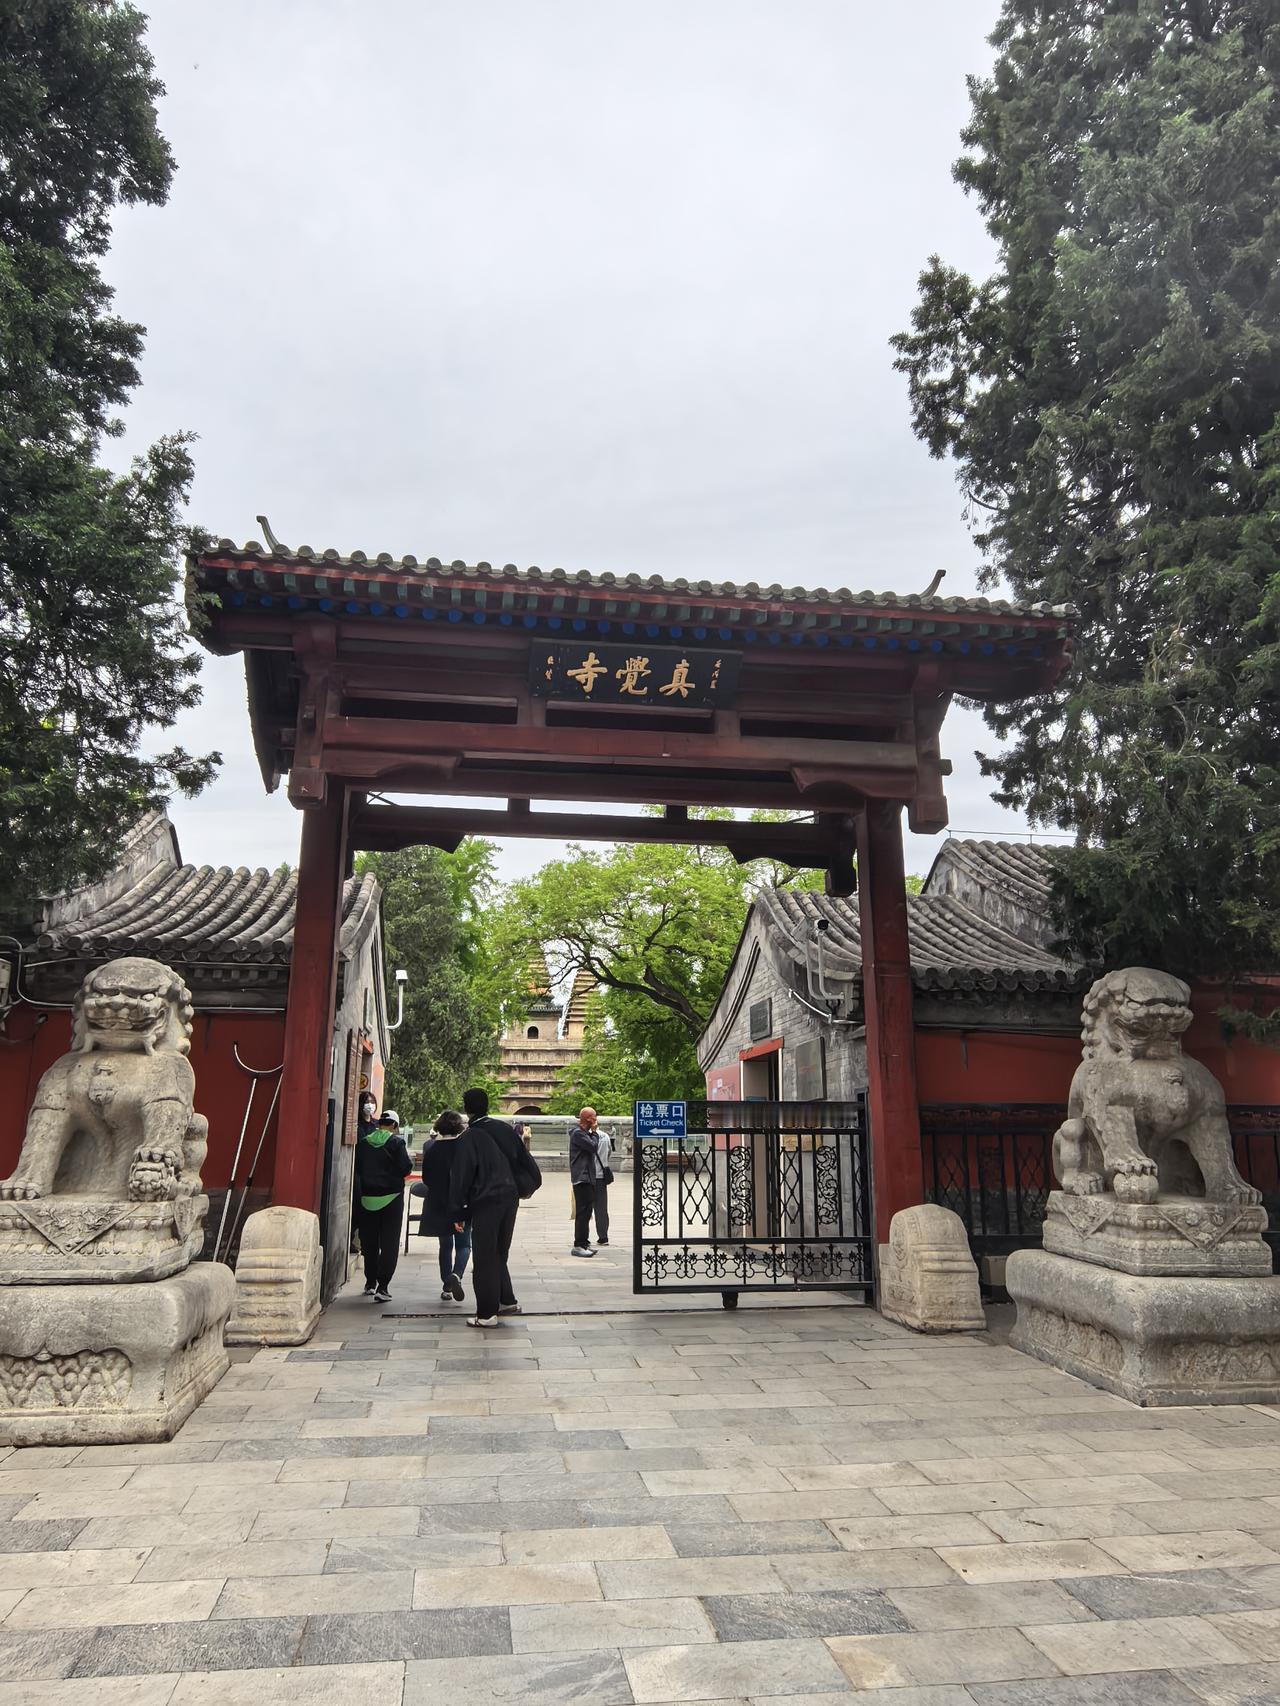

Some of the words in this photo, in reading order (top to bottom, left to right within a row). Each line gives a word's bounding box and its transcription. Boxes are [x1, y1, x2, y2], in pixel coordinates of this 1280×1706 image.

[640, 1103, 683, 1118] 检票口
[639, 1119, 660, 1127] Ticket
[661, 1119, 684, 1127] Check
